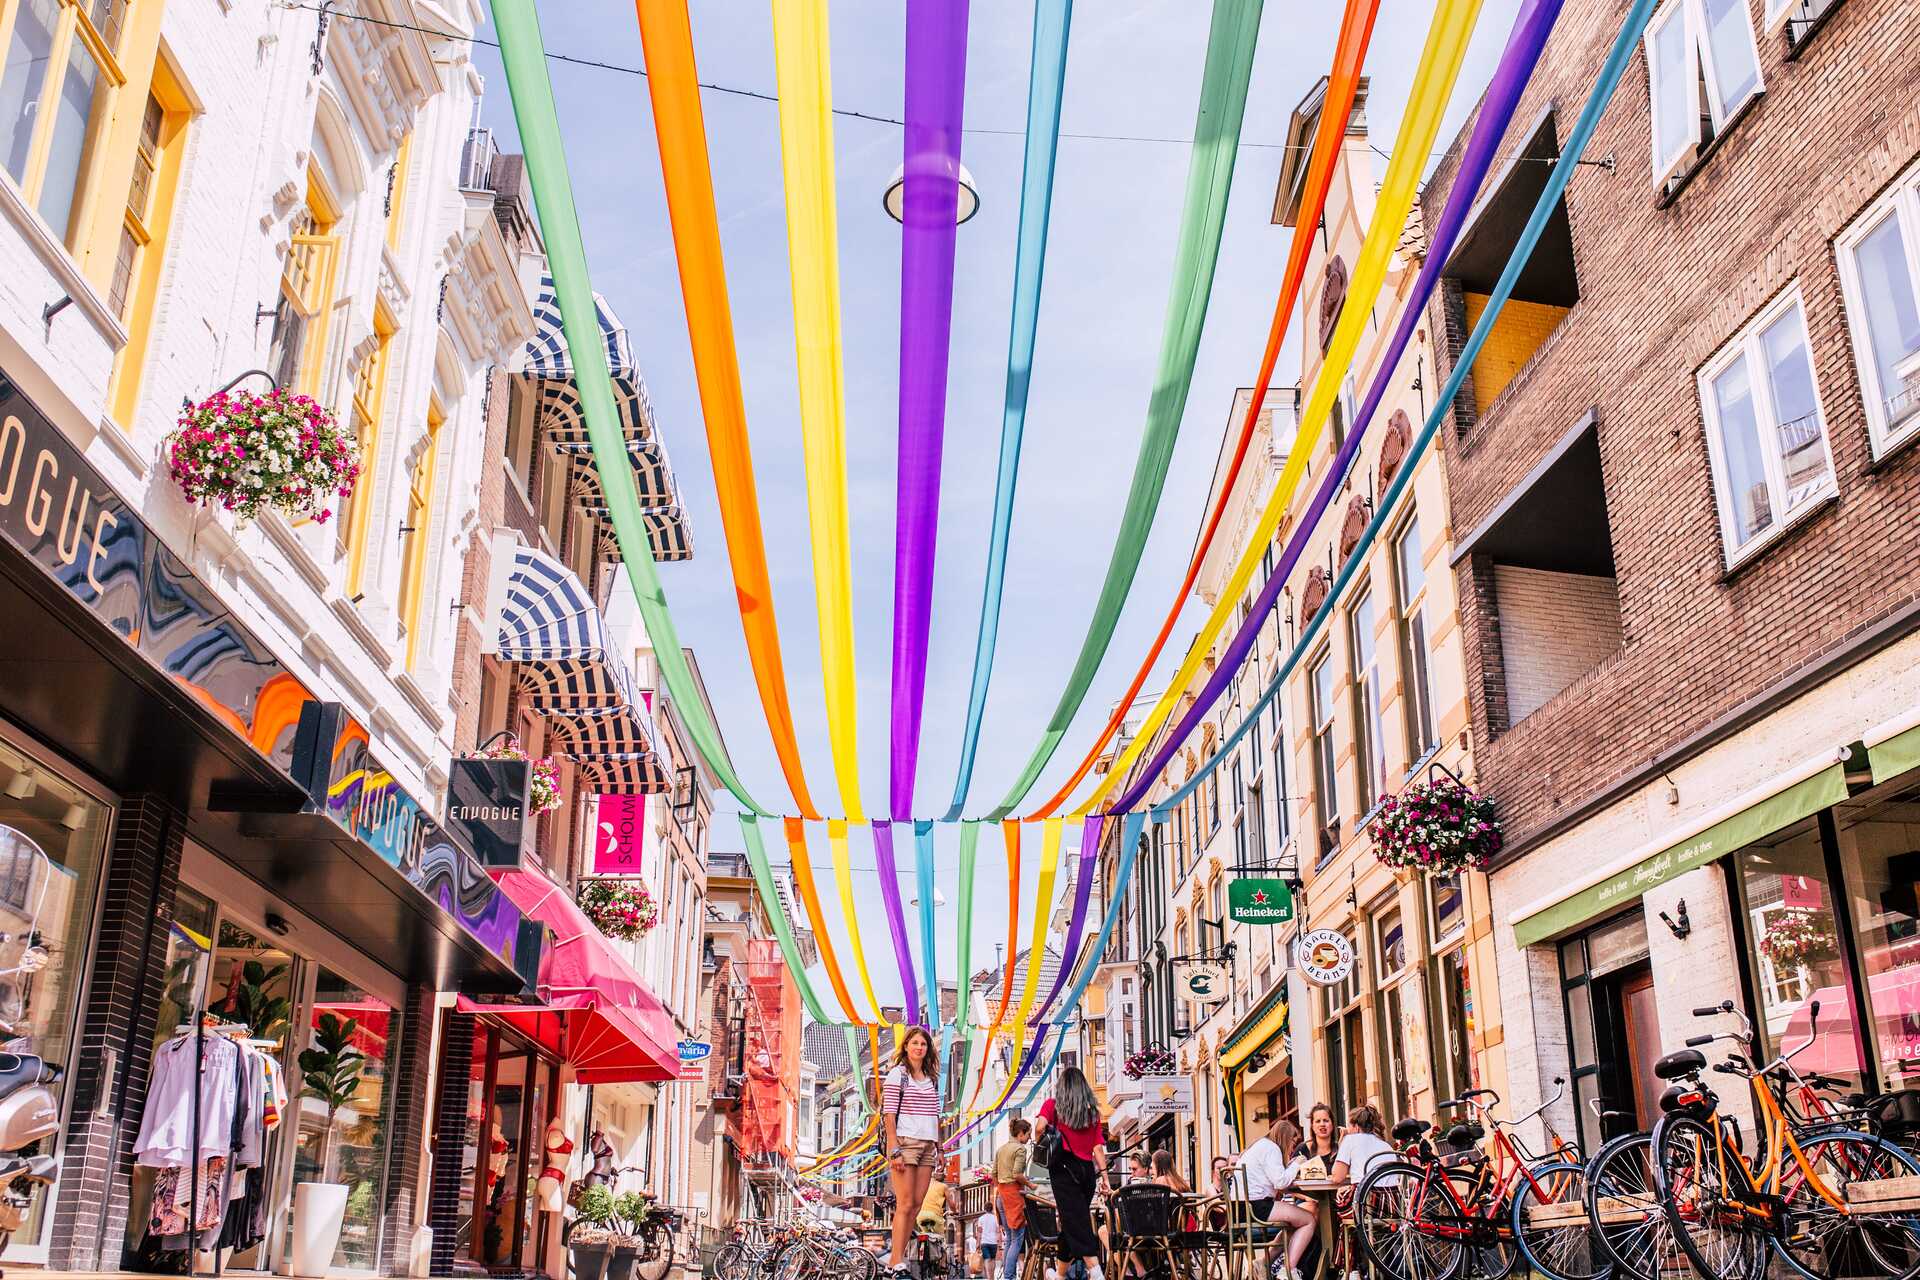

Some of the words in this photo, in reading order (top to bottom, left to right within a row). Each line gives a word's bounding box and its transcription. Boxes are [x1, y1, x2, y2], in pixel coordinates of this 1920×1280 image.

[451, 805, 520, 821] ENVOGUE
[1234, 906, 1287, 917] Heineken
[1304, 932, 1349, 951] BAGELS
[1307, 966, 1346, 980] BEANS
